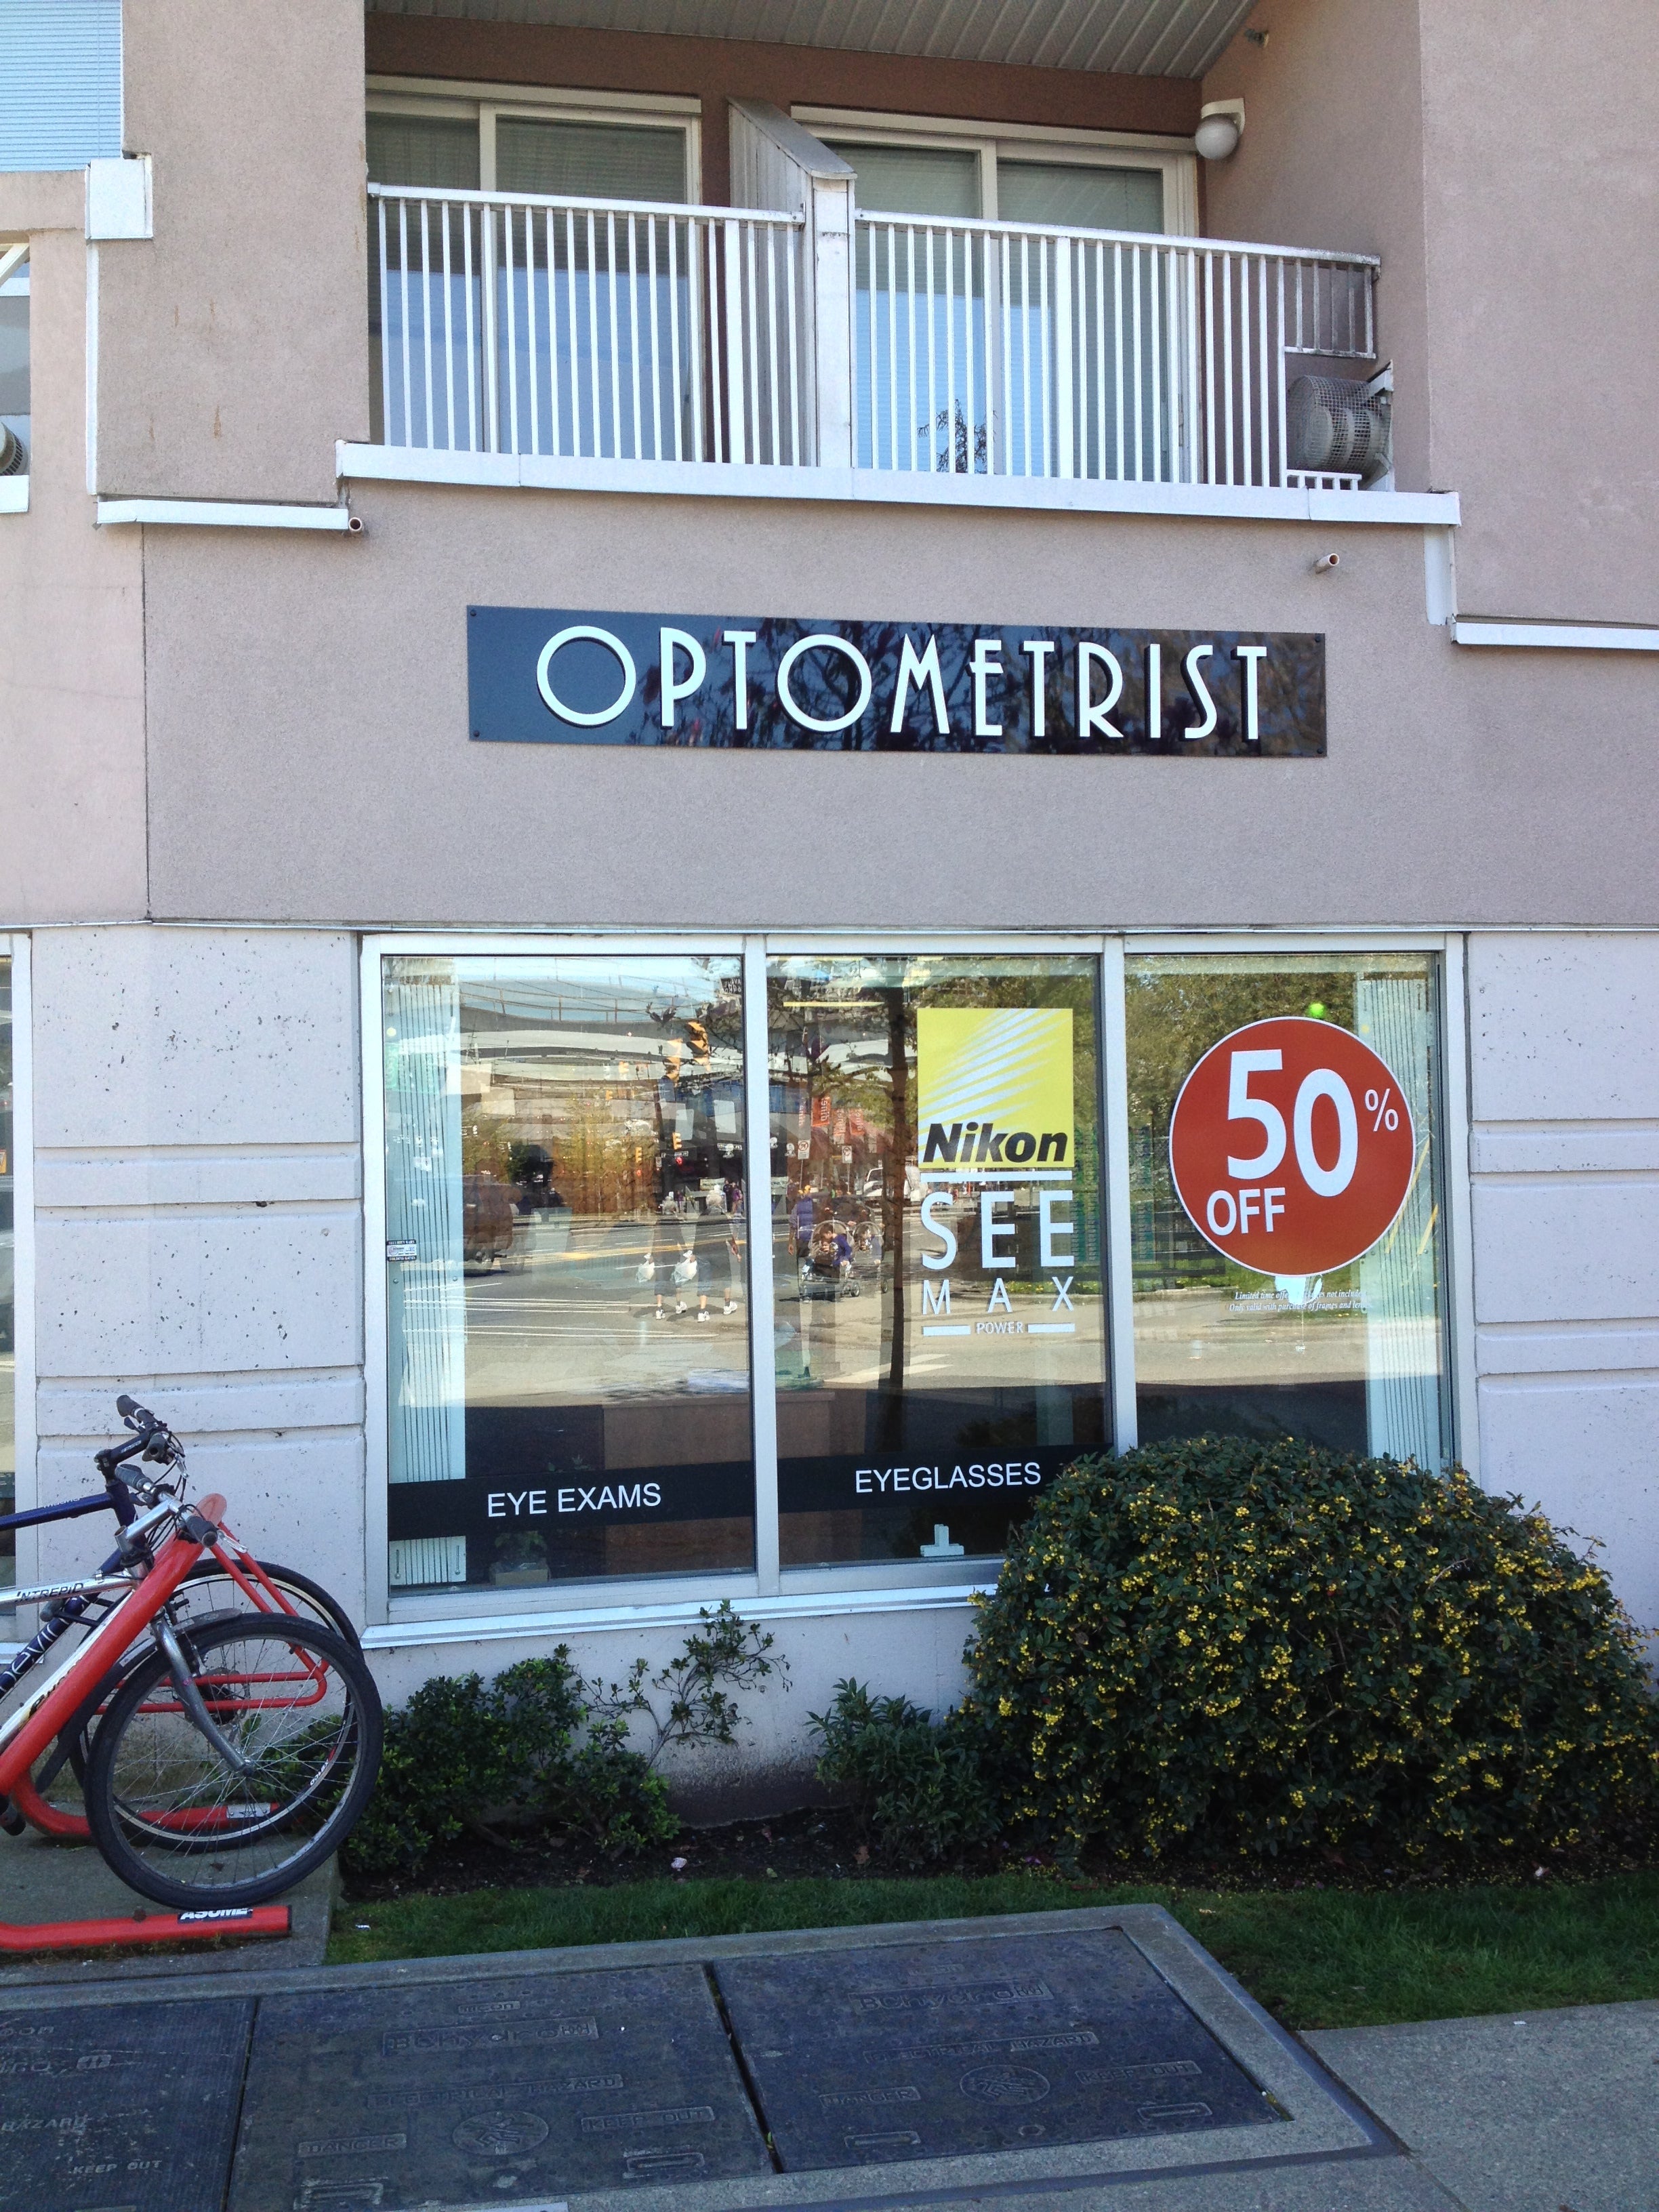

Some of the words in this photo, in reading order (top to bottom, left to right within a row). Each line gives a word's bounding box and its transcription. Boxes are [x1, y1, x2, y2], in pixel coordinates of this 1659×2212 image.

[537, 626, 1267, 740] OPTOMETRIST
[922, 1122, 1068, 1163] Nikon
[1207, 1187, 1286, 1236] OFF
[921, 1190, 1075, 1270] SEE
[922, 1276, 1075, 1315] MAX
[1235, 1291, 1259, 1300] Limited
[1261, 1290, 1274, 1299] time
[1276, 1290, 1289, 1300] offe
[1229, 1303, 1244, 1312] Only
[1246, 1303, 1262, 1311] valid
[1263, 1302, 1277, 1311] with
[1308, 1302, 1316, 1311] of
[1315, 1301, 1337, 1311] frames
[1339, 1300, 1351, 1309] and
[976, 1321, 1024, 1335] POWER
[855, 1462, 1042, 1493] EYEGLASSES
[488, 1490, 547, 1517] EYE
[558, 1483, 661, 1512] EXAMS
[14, 1582, 84, 1601] INTREPID
[1152, 2064, 1189, 2075] OUT
[662, 2110, 703, 2122] OUT
[308, 2137, 400, 2153] DANGER
[68, 2164, 117, 2174] KEEP
[127, 2160, 162, 2171] OUT
